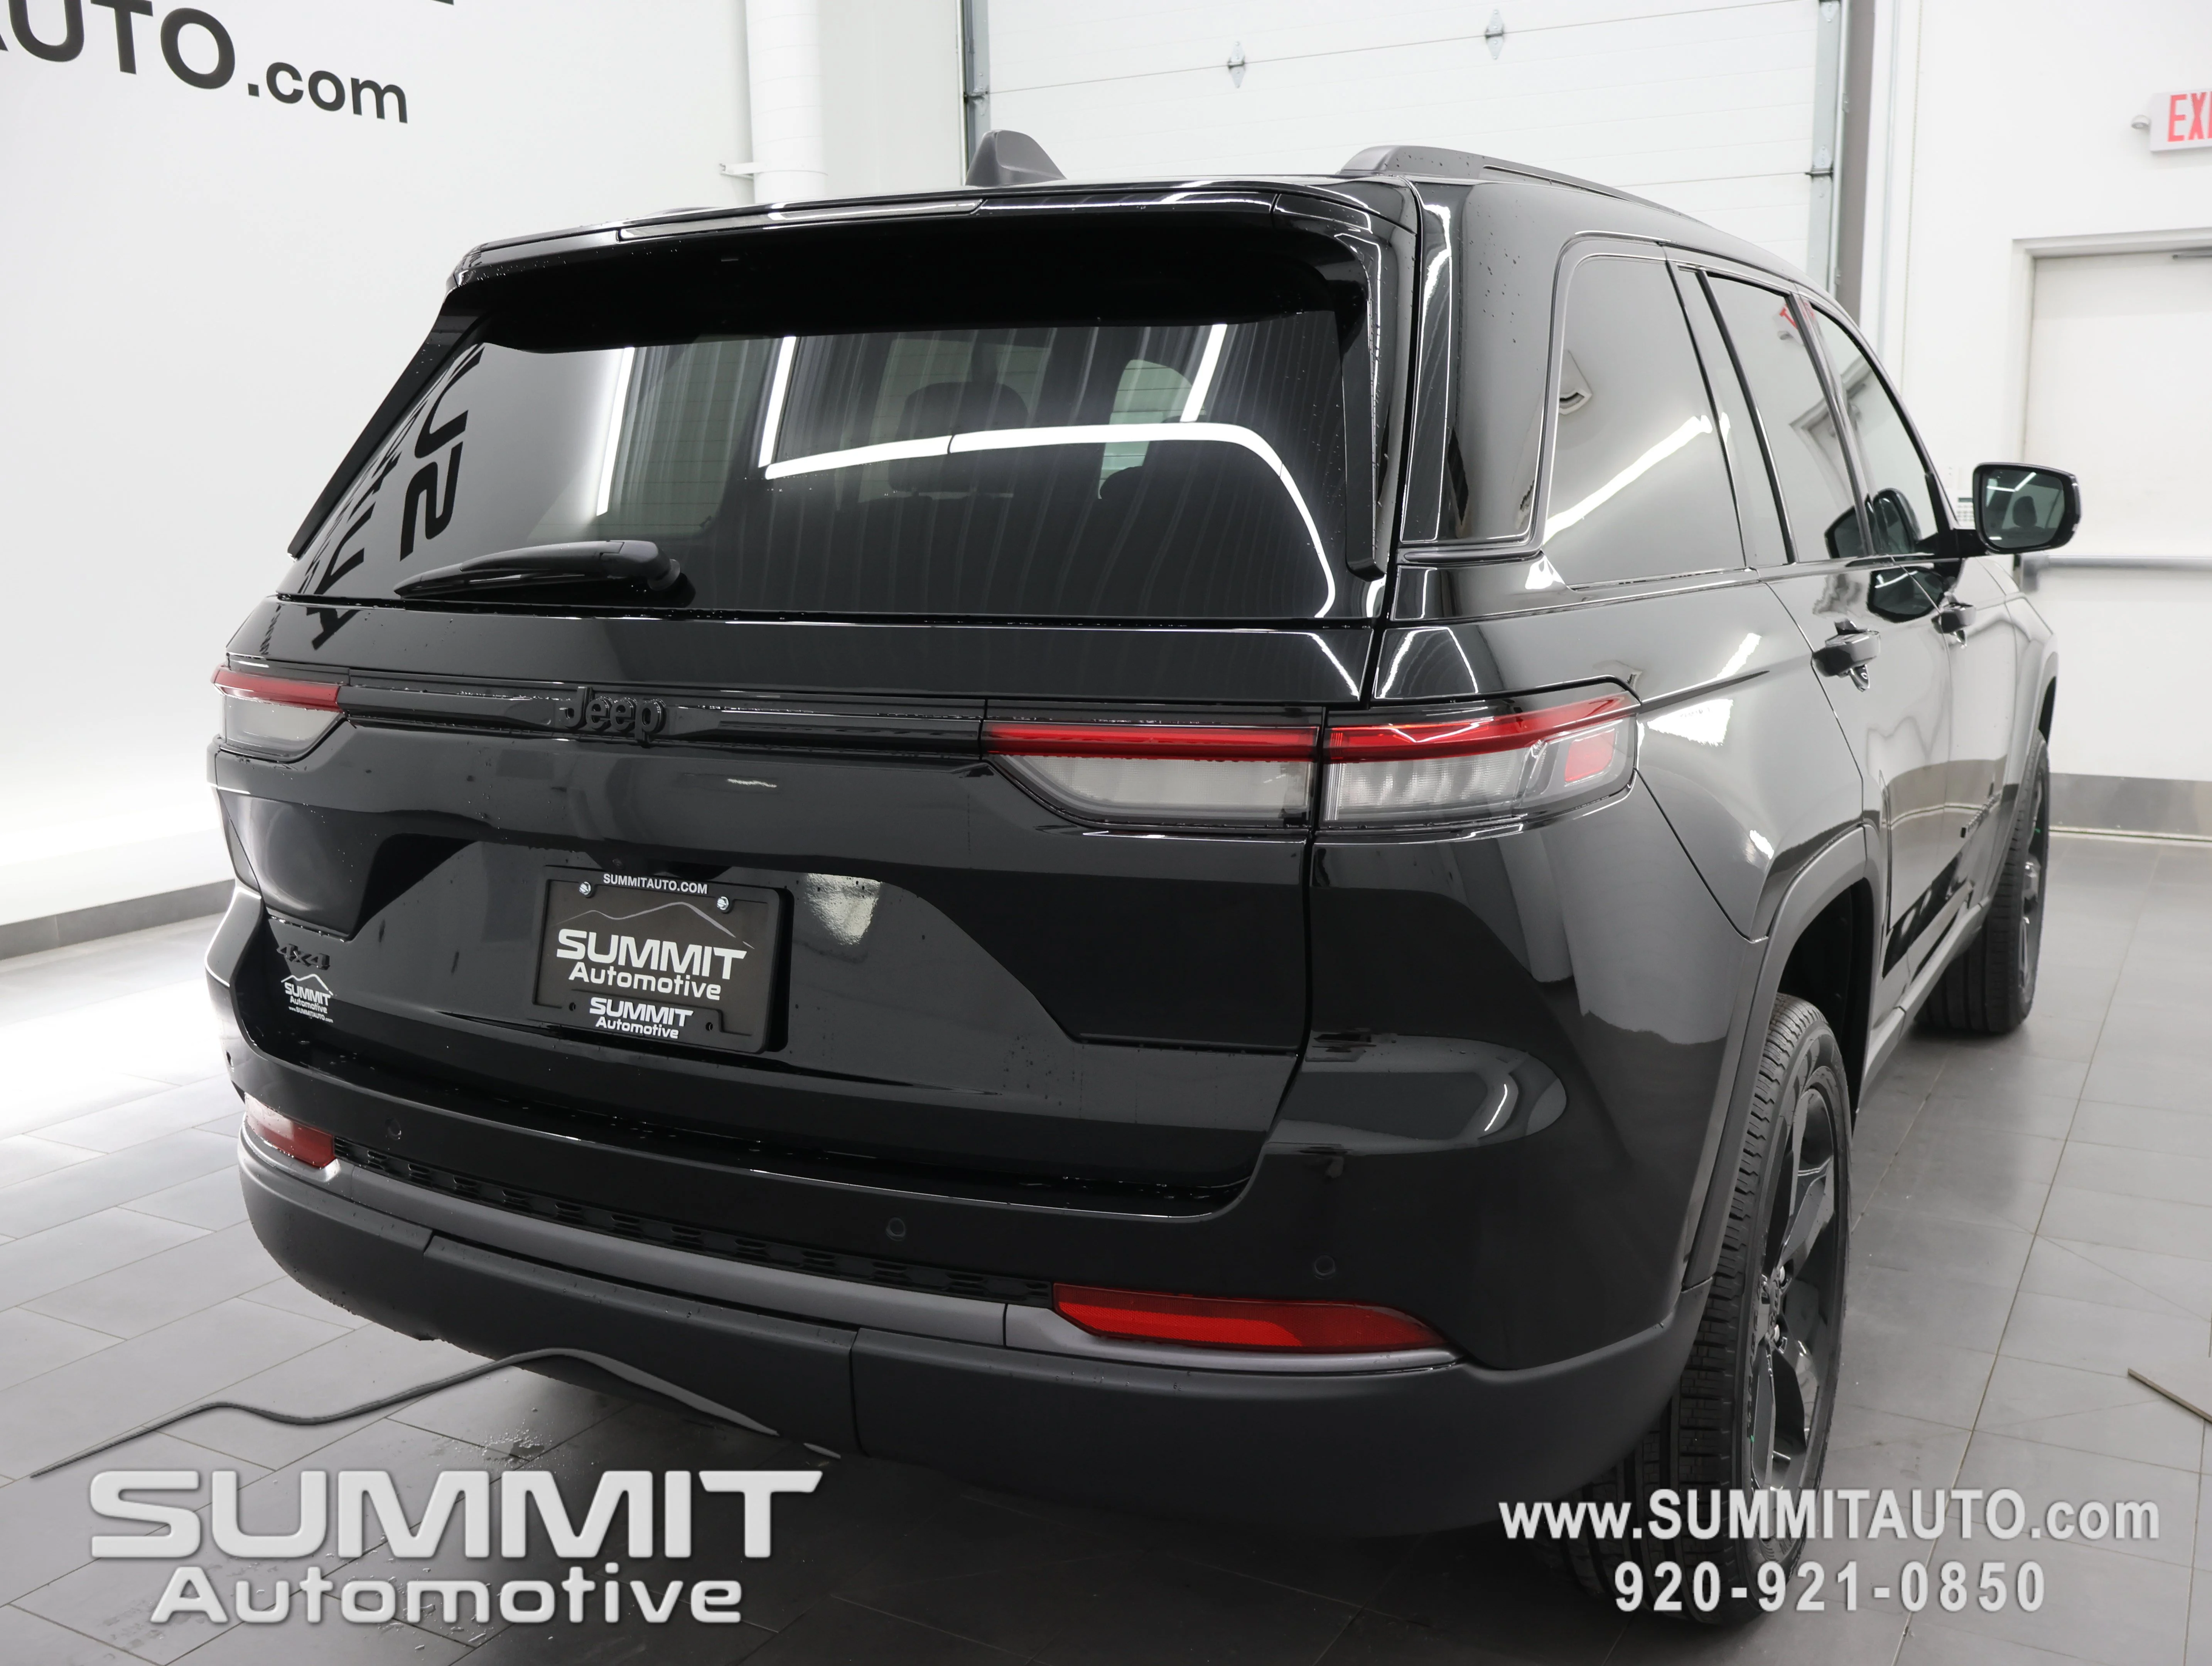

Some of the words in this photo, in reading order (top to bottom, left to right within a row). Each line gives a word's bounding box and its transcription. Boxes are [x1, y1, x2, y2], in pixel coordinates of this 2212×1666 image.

[0, 0, 408, 124] UTO.com
[559, 686, 666, 745] Jeep
[603, 873, 708, 895] SUMMITAUTO.COM
[557, 928, 747, 980] SUMMIT
[285, 982, 331, 1006] SUMMIT
[569, 962, 721, 1001] Automotive
[290, 996, 327, 1014] Automotive
[589, 997, 693, 1027] SUMMIT
[595, 1016, 679, 1039] Automotive
